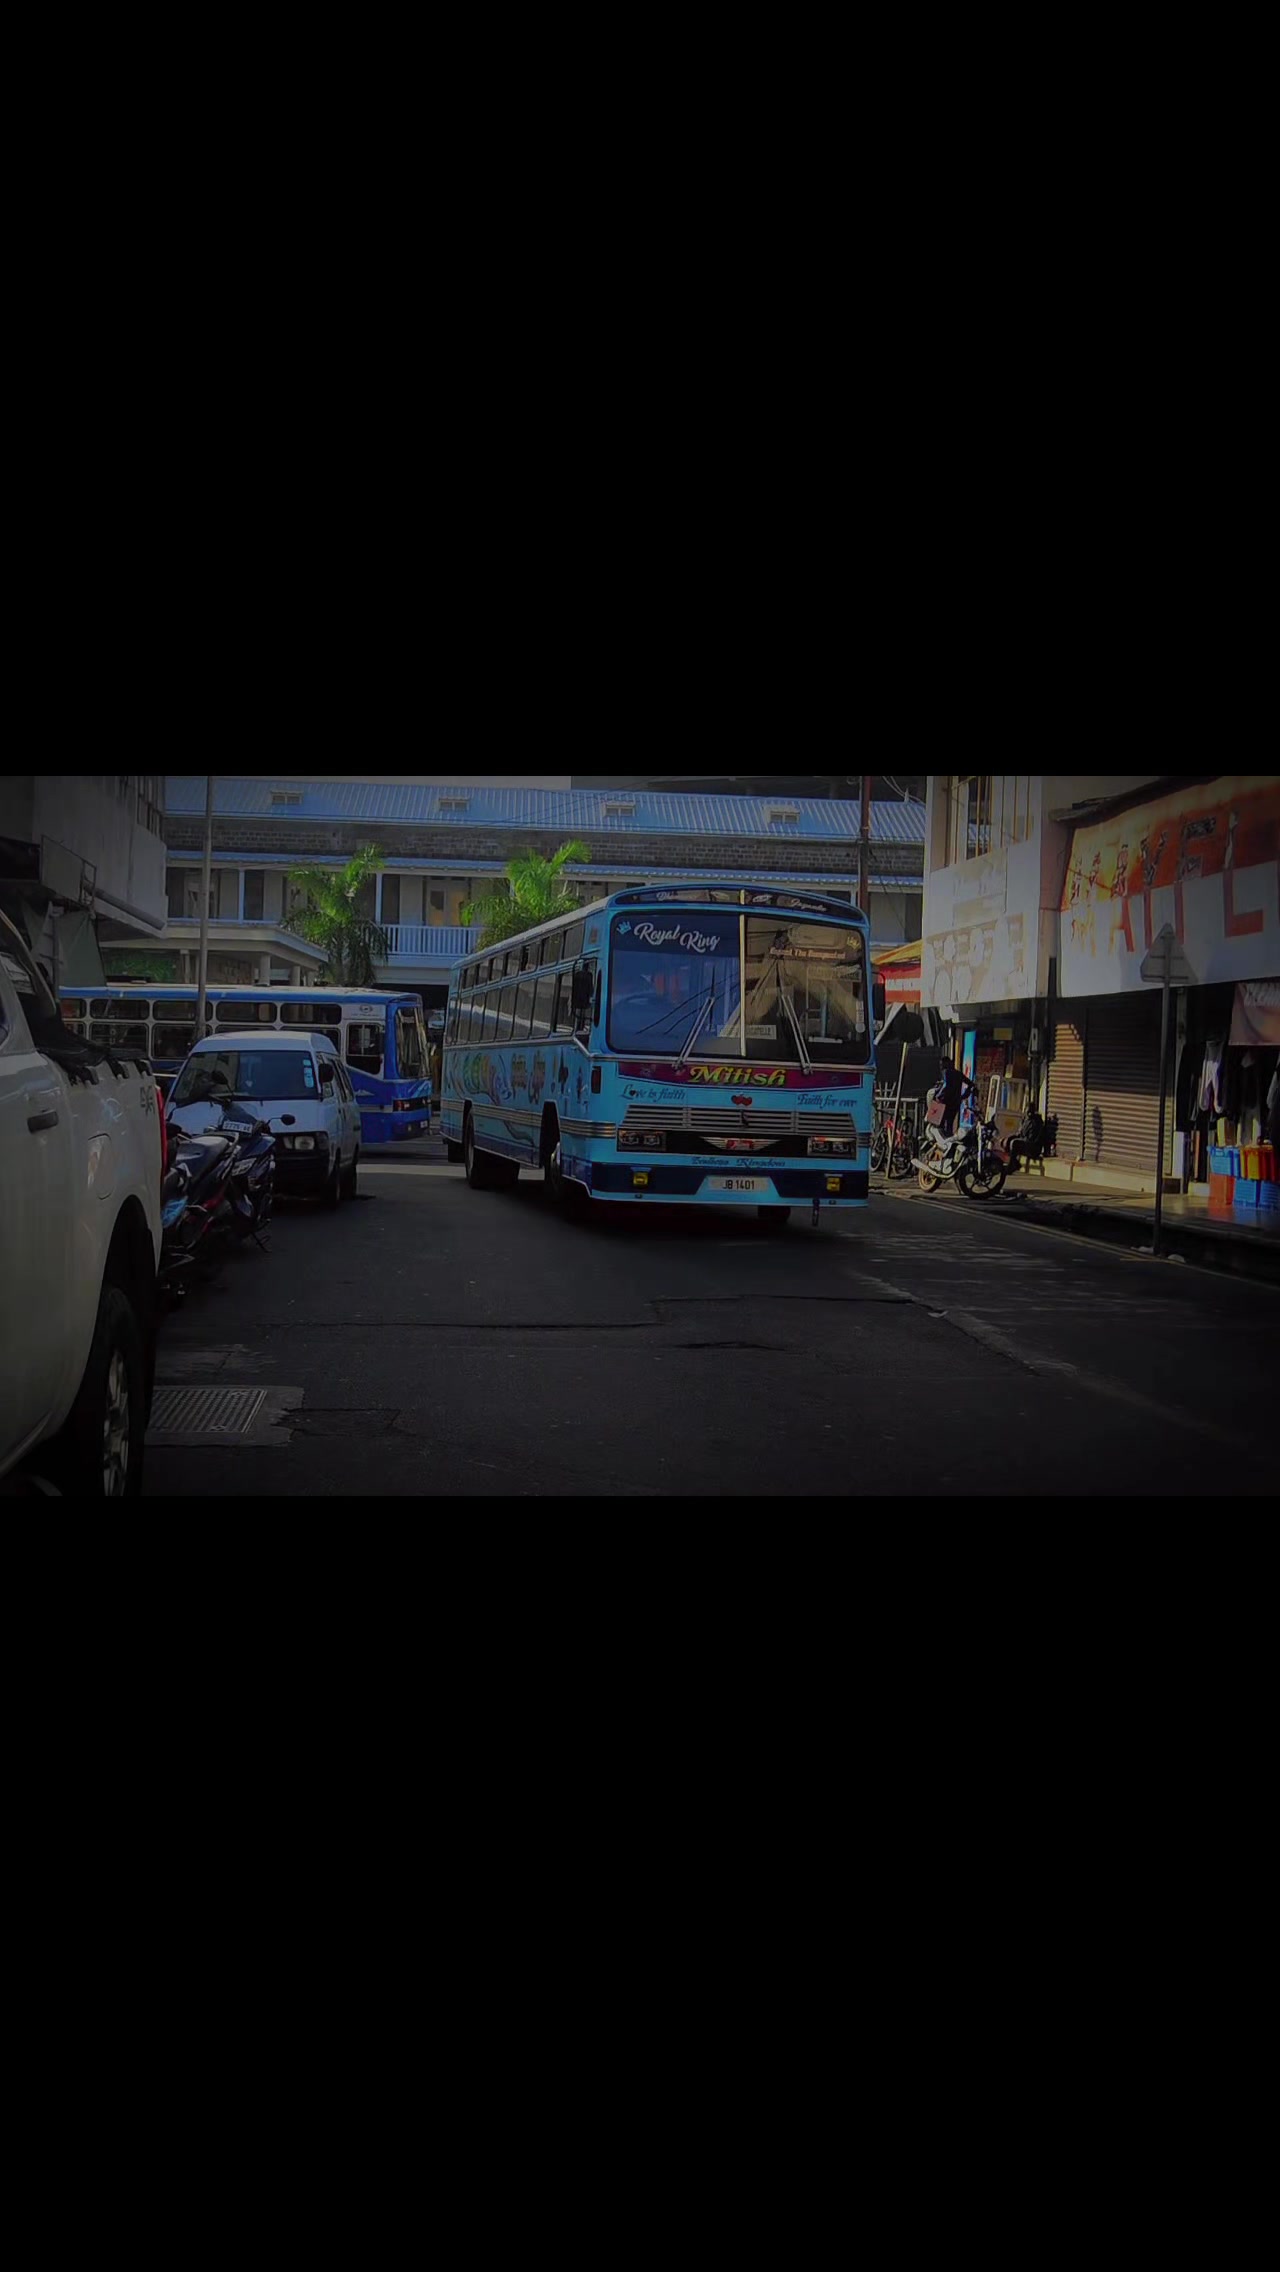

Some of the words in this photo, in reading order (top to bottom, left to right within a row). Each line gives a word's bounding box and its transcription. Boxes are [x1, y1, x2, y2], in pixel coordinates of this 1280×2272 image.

[633, 922, 681, 946] Royal
[680, 930, 721, 954] King
[688, 1065, 787, 1087] Mitish
[722, 1179, 733, 1190] JB
[735, 1180, 756, 1191] 1401
